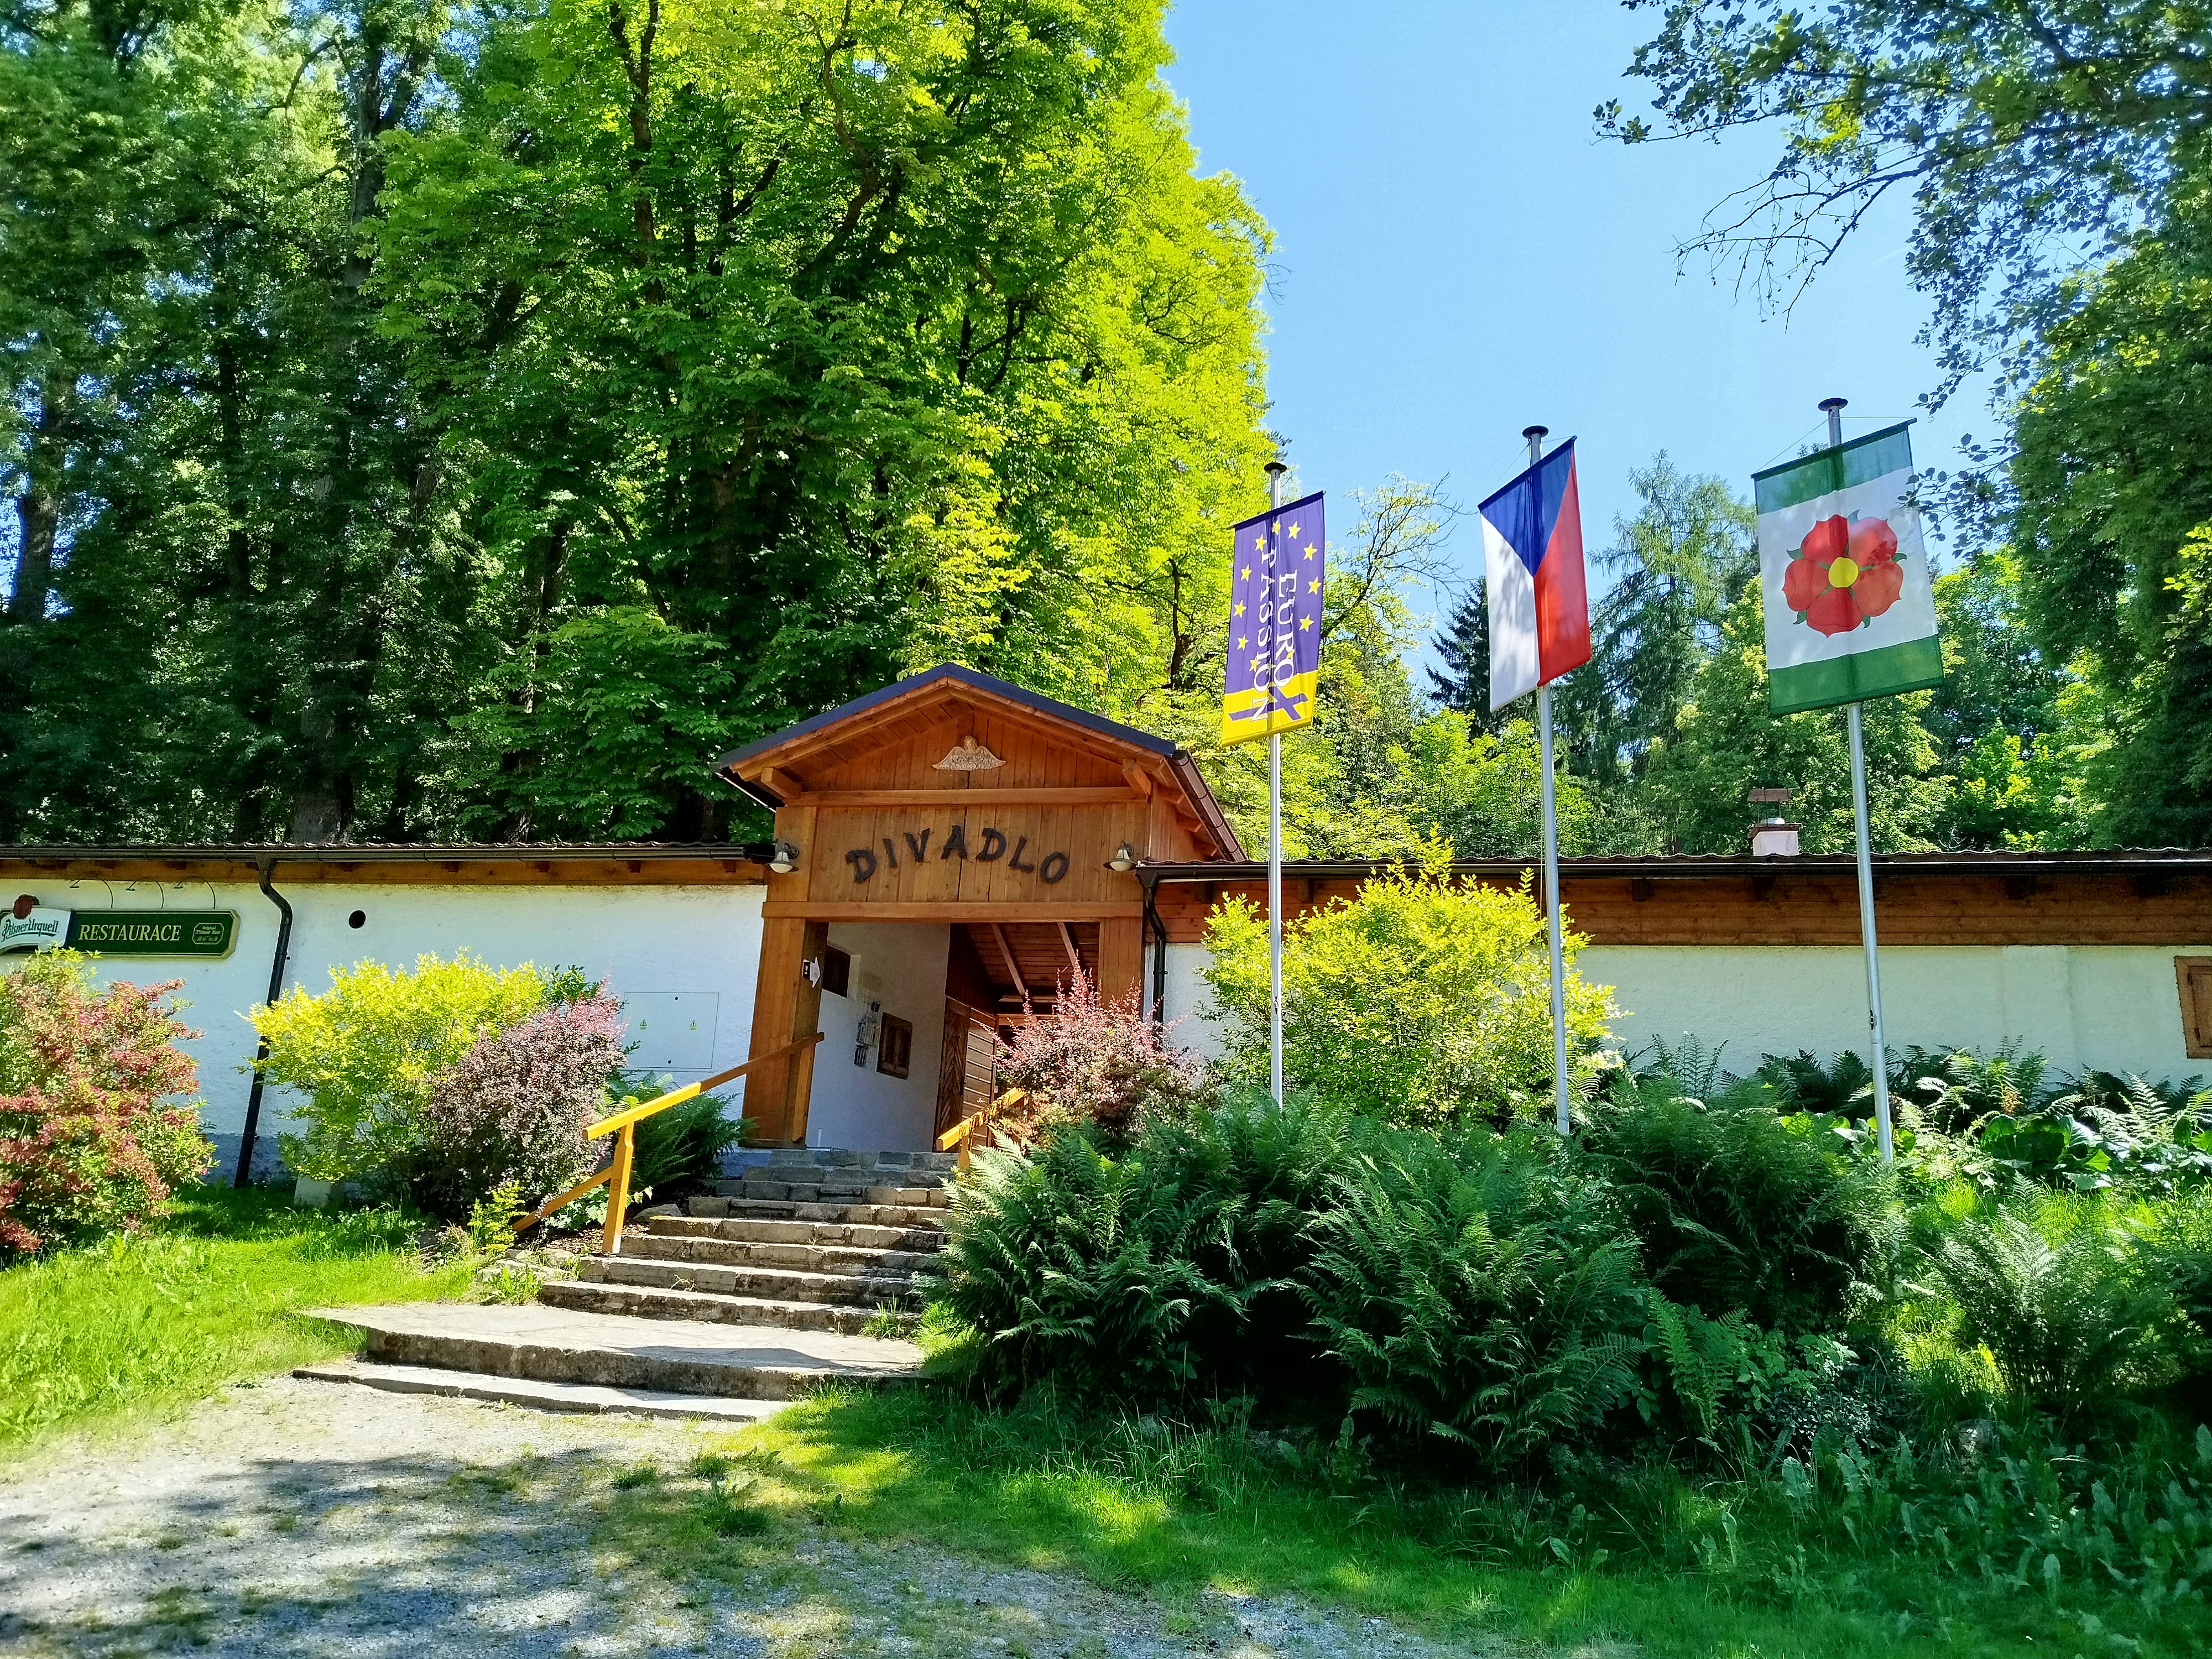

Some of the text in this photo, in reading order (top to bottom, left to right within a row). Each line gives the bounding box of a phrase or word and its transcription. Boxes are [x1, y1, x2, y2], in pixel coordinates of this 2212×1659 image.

[1250, 546, 1277, 722] PASSION
[1273, 569, 1297, 688] EURO
[844, 824, 1070, 883] DIVADLO
[1, 917, 59, 942] Pilsner Urquell
[78, 925, 181, 941] RESTAURACE
